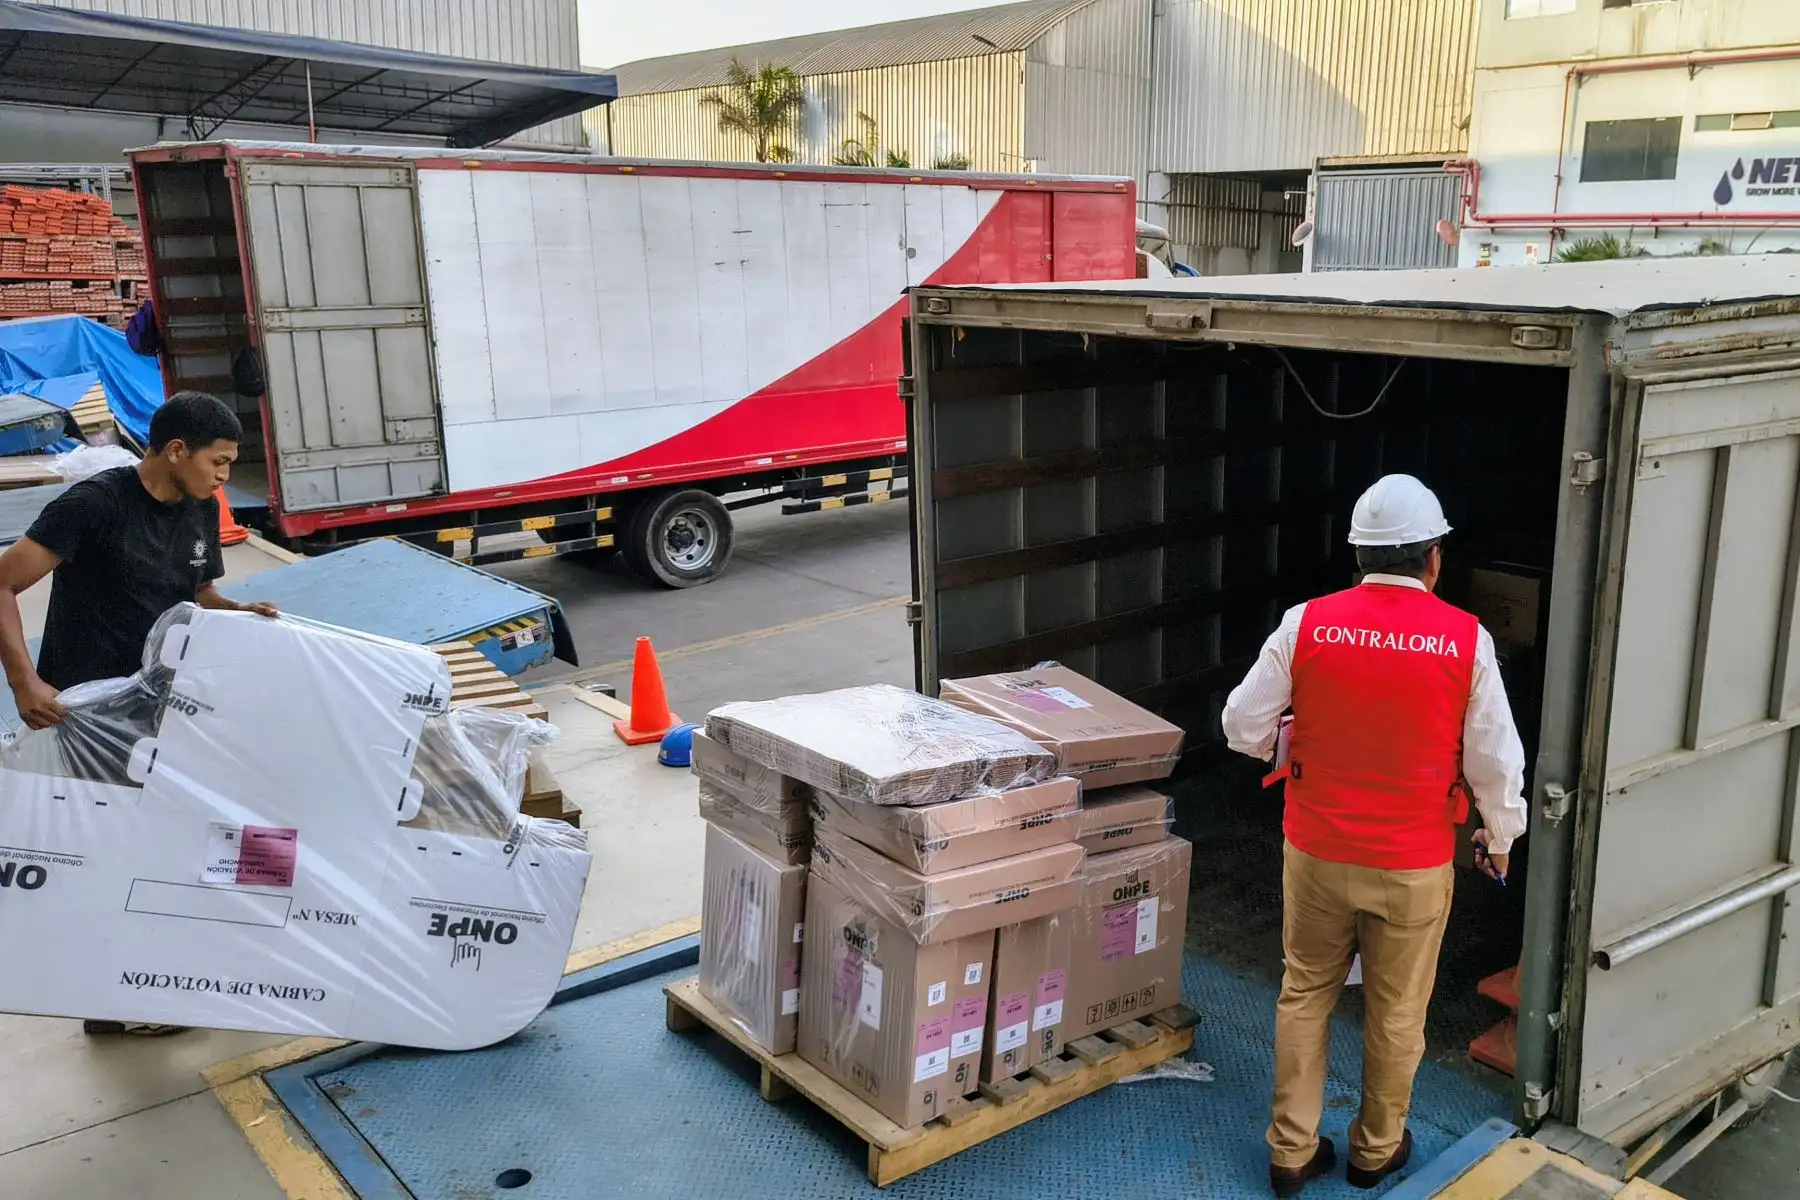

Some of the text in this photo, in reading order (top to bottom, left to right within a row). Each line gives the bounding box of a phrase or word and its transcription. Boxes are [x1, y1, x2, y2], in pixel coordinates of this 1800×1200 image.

[1746, 187, 1771, 197] GROW
[1772, 187, 1795, 196] MORE
[1313, 625, 1460, 658] CONTRALORÍA
[12, 852, 51, 863] Nacional
[52, 857, 83, 867] Oficina
[206, 865, 244, 875] VOTACIÓN
[1113, 880, 1150, 900] ONPE
[448, 905, 480, 916] Procesos
[480, 910, 490, 918] de
[490, 911, 521, 921] Nacional
[315, 910, 360, 926] MESA
[427, 912, 518, 945] ONPE
[119, 971, 326, 1002] CABINA DE VOTACIÓN
